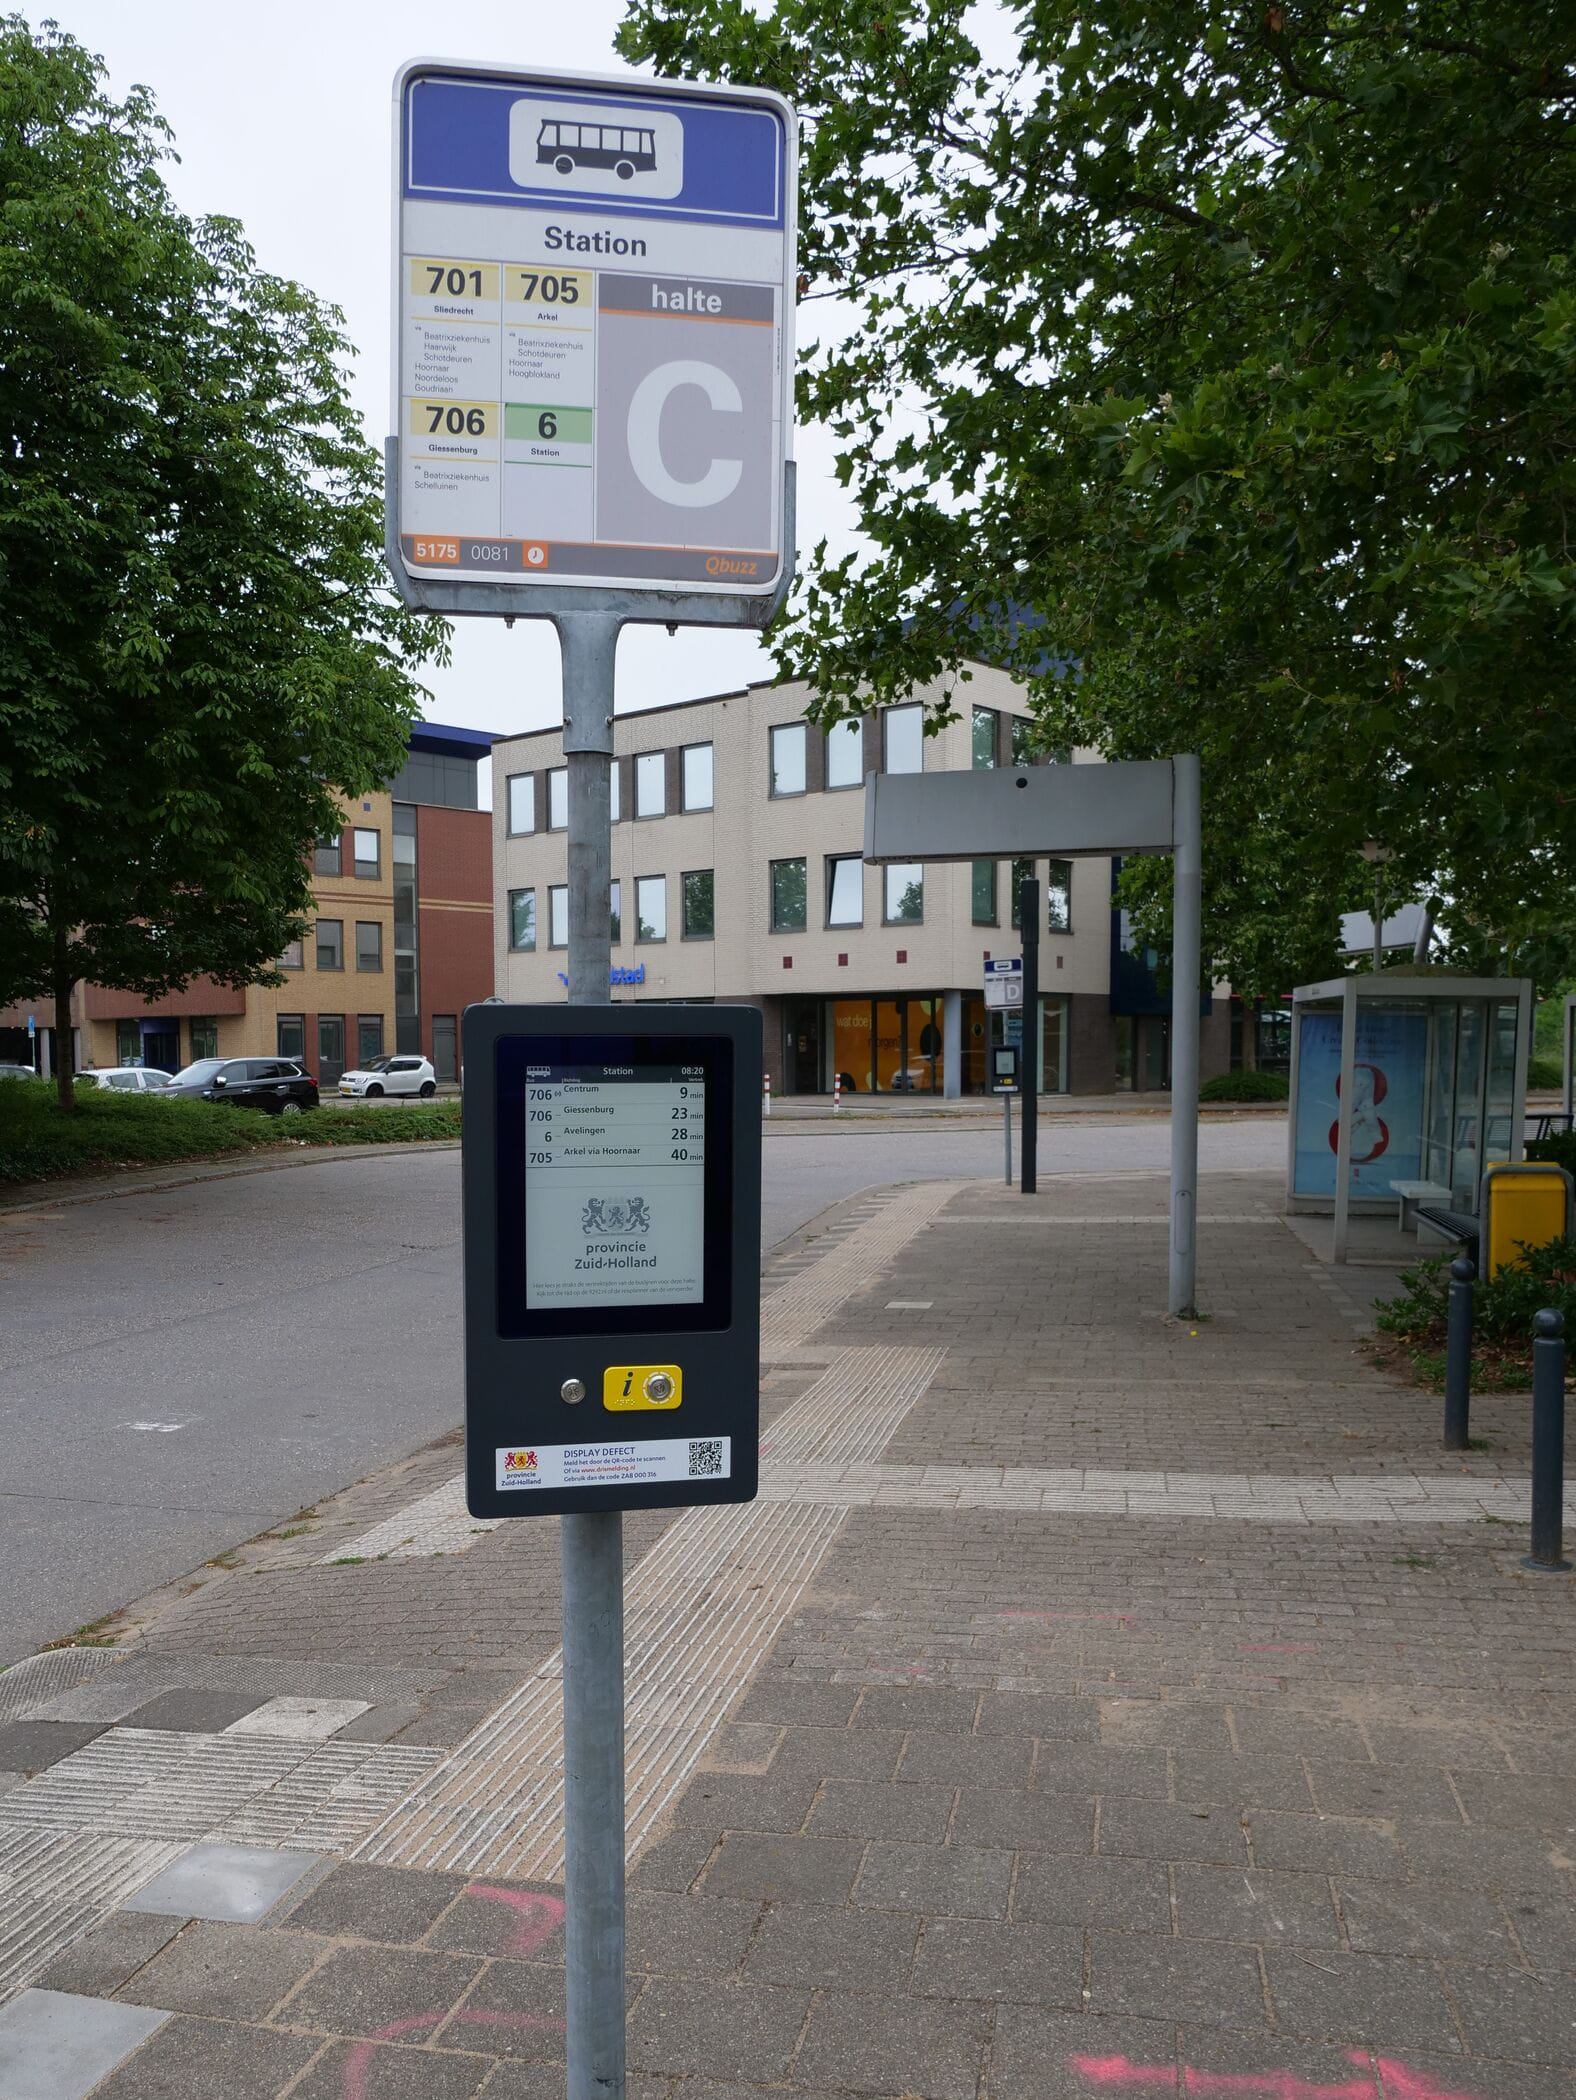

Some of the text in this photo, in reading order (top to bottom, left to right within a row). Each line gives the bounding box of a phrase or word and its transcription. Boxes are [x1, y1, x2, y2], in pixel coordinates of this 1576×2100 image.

[545, 226, 647, 256] Station
[426, 266, 482, 297] 701
[520, 274, 579, 304] 705
[652, 284, 722, 314] halte
[434, 305, 474, 315] Sliedrecht
[538, 313, 558, 321] Arkel
[424, 332, 490, 344] Beatrixziekenhuis
[424, 344, 457, 353] Haarwijk
[518, 338, 583, 350] Beatrixziekenhuis
[424, 353, 472, 363] Schotdeuren
[518, 349, 566, 359] Schotdeuren
[415, 363, 449, 372] Hoornaar
[508, 359, 543, 368] Hoornaar
[415, 374, 458, 384] Noordeloos
[509, 369, 560, 380] Hoogblokland
[415, 384, 453, 393] Goudriaan
[426, 405, 485, 436] 706
[538, 412, 557, 440] 6
[626, 359, 744, 508] C
[429, 444, 478, 455] Giessenburg
[531, 447, 560, 457] Station
[423, 471, 490, 482] Beatrixziekenhuis
[414, 481, 458, 491] Schelluinen
[416, 543, 509, 562] 5175 0081
[705, 555, 758, 577] Qbuzz
[1007, 984, 1020, 999] D
[603, 1067, 633, 1075] Station
[681, 1067, 704, 1075] 08:20
[529, 1090, 552, 1101] 706
[564, 1085, 599, 1093] Centrum
[680, 1087, 688, 1099] 9
[529, 1111, 552, 1122] 706
[564, 1106, 614, 1115] Giessenburg
[671, 1108, 688, 1120] 23
[544, 1131, 552, 1142] 6
[564, 1127, 605, 1136] Avelingen
[671, 1128, 688, 1140] 28
[529, 1153, 552, 1163] 705
[671, 1149, 688, 1161] 40
[586, 1241, 646, 1256] provincie
[574, 1256, 657, 1269] Zuid-Holland
[564, 1447, 635, 1458] DISPLAY DEFECT
[507, 1471, 536, 1479] provincie
[501, 1478, 541, 1486] Zuid-Holland
